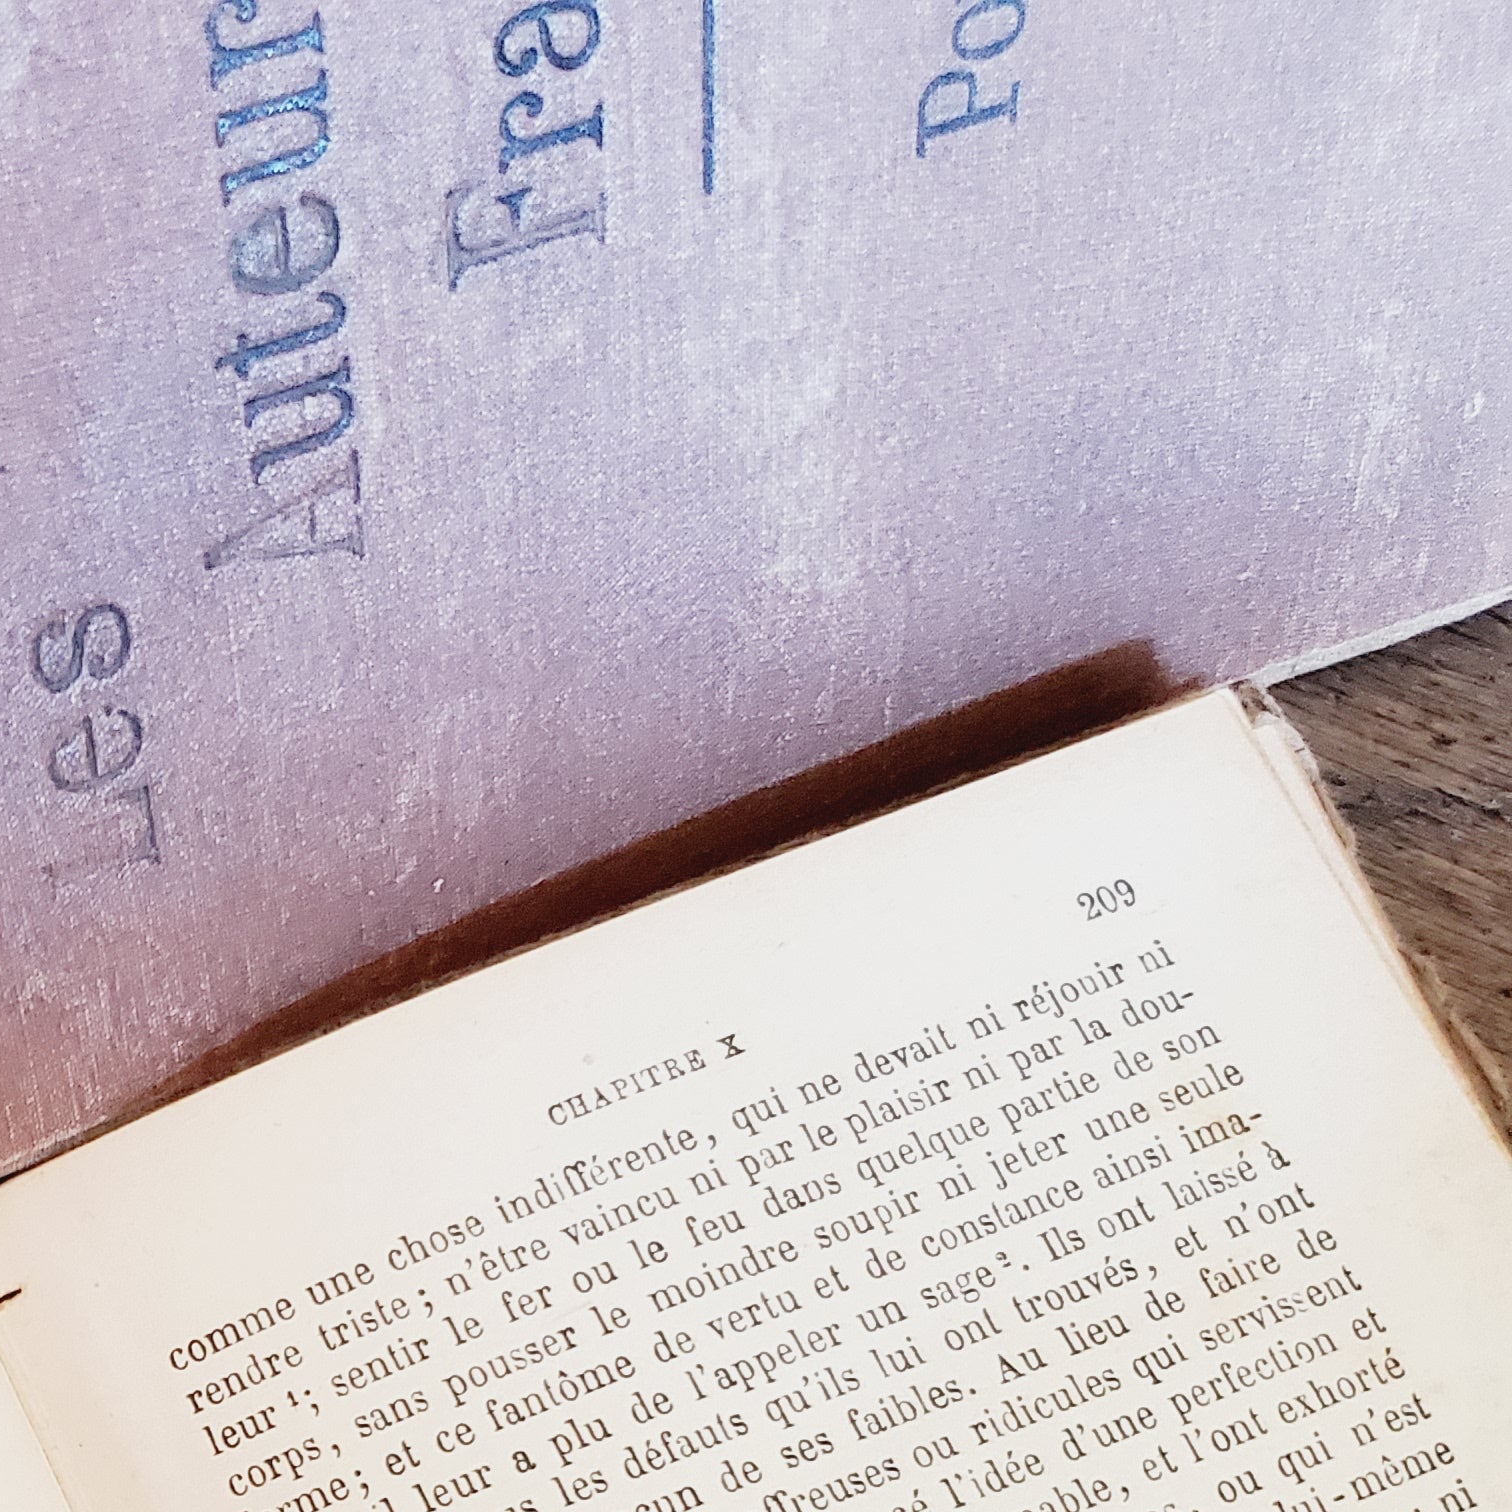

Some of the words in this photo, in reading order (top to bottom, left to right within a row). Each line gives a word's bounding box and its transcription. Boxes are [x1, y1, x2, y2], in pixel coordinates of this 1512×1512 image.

[445, 0, 609, 293] Fra
[915, 0, 1026, 159] Po
[33, 603, 161, 882] Les
[1075, 877, 1137, 922] 209
[167, 1297, 297, 1372] comme
[304, 1262, 376, 1307] une
[386, 1214, 486, 1272] chose
[493, 1128, 718, 1225] indifférente,
[730, 1085, 790, 1138] qui
[795, 1073, 843, 1106] ne
[853, 1022, 958, 1084] devait
[965, 1002, 1007, 1041] ni
[1010, 960, 1126, 1023] réjouir
[1137, 938, 1177, 974] ni
[546, 1048, 708, 1127] CHAPITRE
[715, 1032, 747, 1060] X
[549, 1469, 610, 1508] les
[622, 1412, 750, 1480] défauts
[764, 1366, 862, 1431] qu'ils
[867, 1335, 928, 1379] lui
[943, 1306, 1004, 1352] ont
[1011, 1254, 1159, 1324] trouvés,
[1173, 1224, 1209, 1259] et
[1222, 1181, 1317, 1239] n'ont
[911, 1435, 962, 1469] ou
[968, 1367, 1123, 1447] ridicules
[1131, 1332, 1190, 1387] qui
